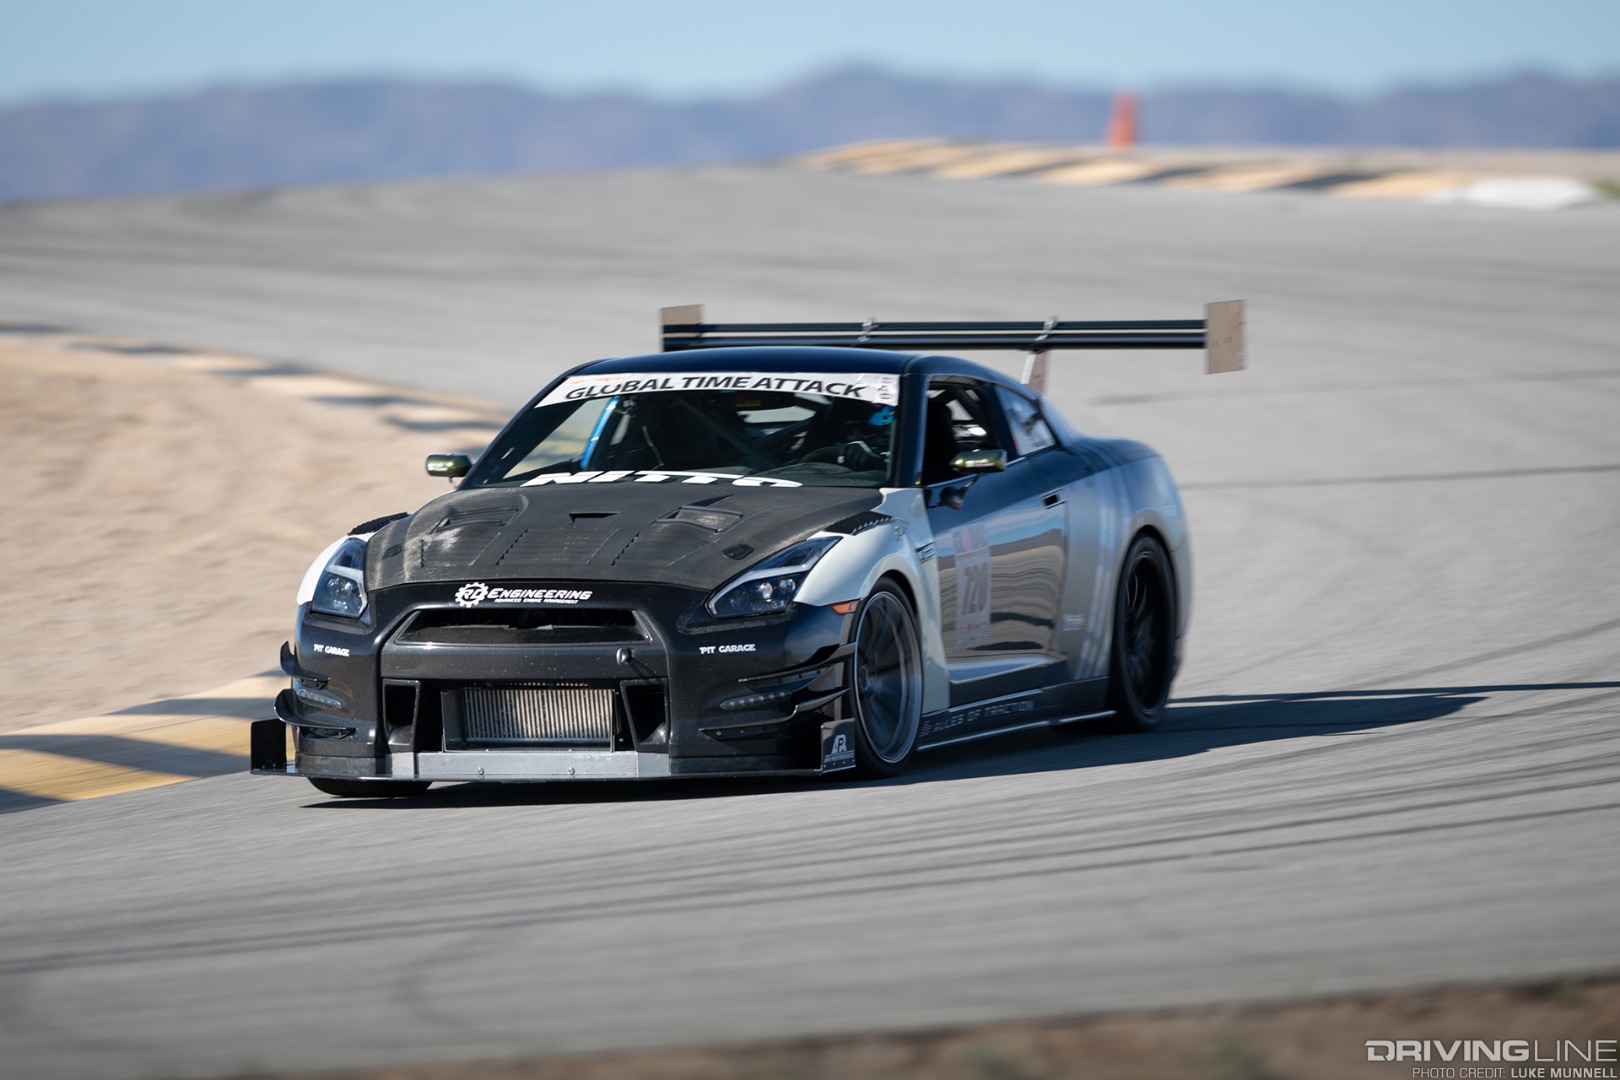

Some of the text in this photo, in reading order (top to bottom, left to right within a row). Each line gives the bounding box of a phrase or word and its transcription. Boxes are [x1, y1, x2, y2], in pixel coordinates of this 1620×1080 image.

[565, 377, 674, 400] GLOBAL
[682, 376, 751, 390] TIME
[751, 377, 867, 398] ATTACK
[520, 470, 803, 488] NITTO
[487, 587, 593, 601] ENGINEERING
[313, 643, 350, 658] PIT GARAGE
[699, 643, 757, 655] PIT GARAGE
[966, 709, 982, 722] OF
